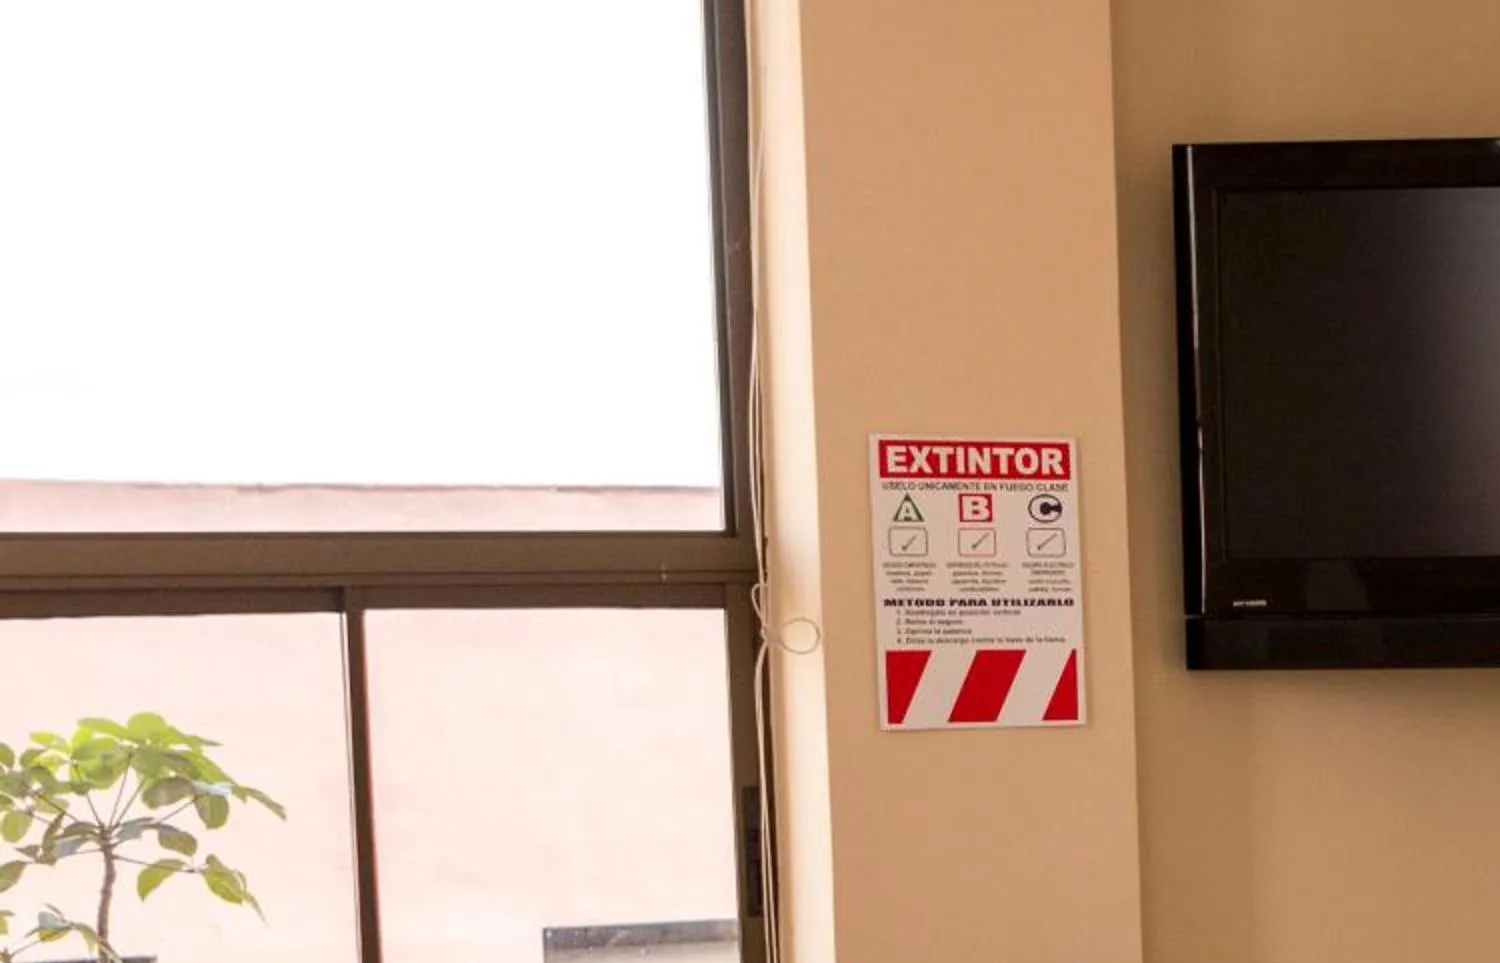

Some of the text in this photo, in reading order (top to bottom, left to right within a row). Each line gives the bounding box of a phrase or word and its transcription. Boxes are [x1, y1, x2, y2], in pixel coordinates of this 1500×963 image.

[885, 445, 1065, 476] EXTINTOR
[1035, 483, 1069, 493] CLASE
[895, 495, 922, 522] A
[962, 496, 991, 522] B
[1028, 494, 1063, 523] C
[949, 599, 988, 607] PARA
[991, 599, 1075, 607] UTILIZARLO
